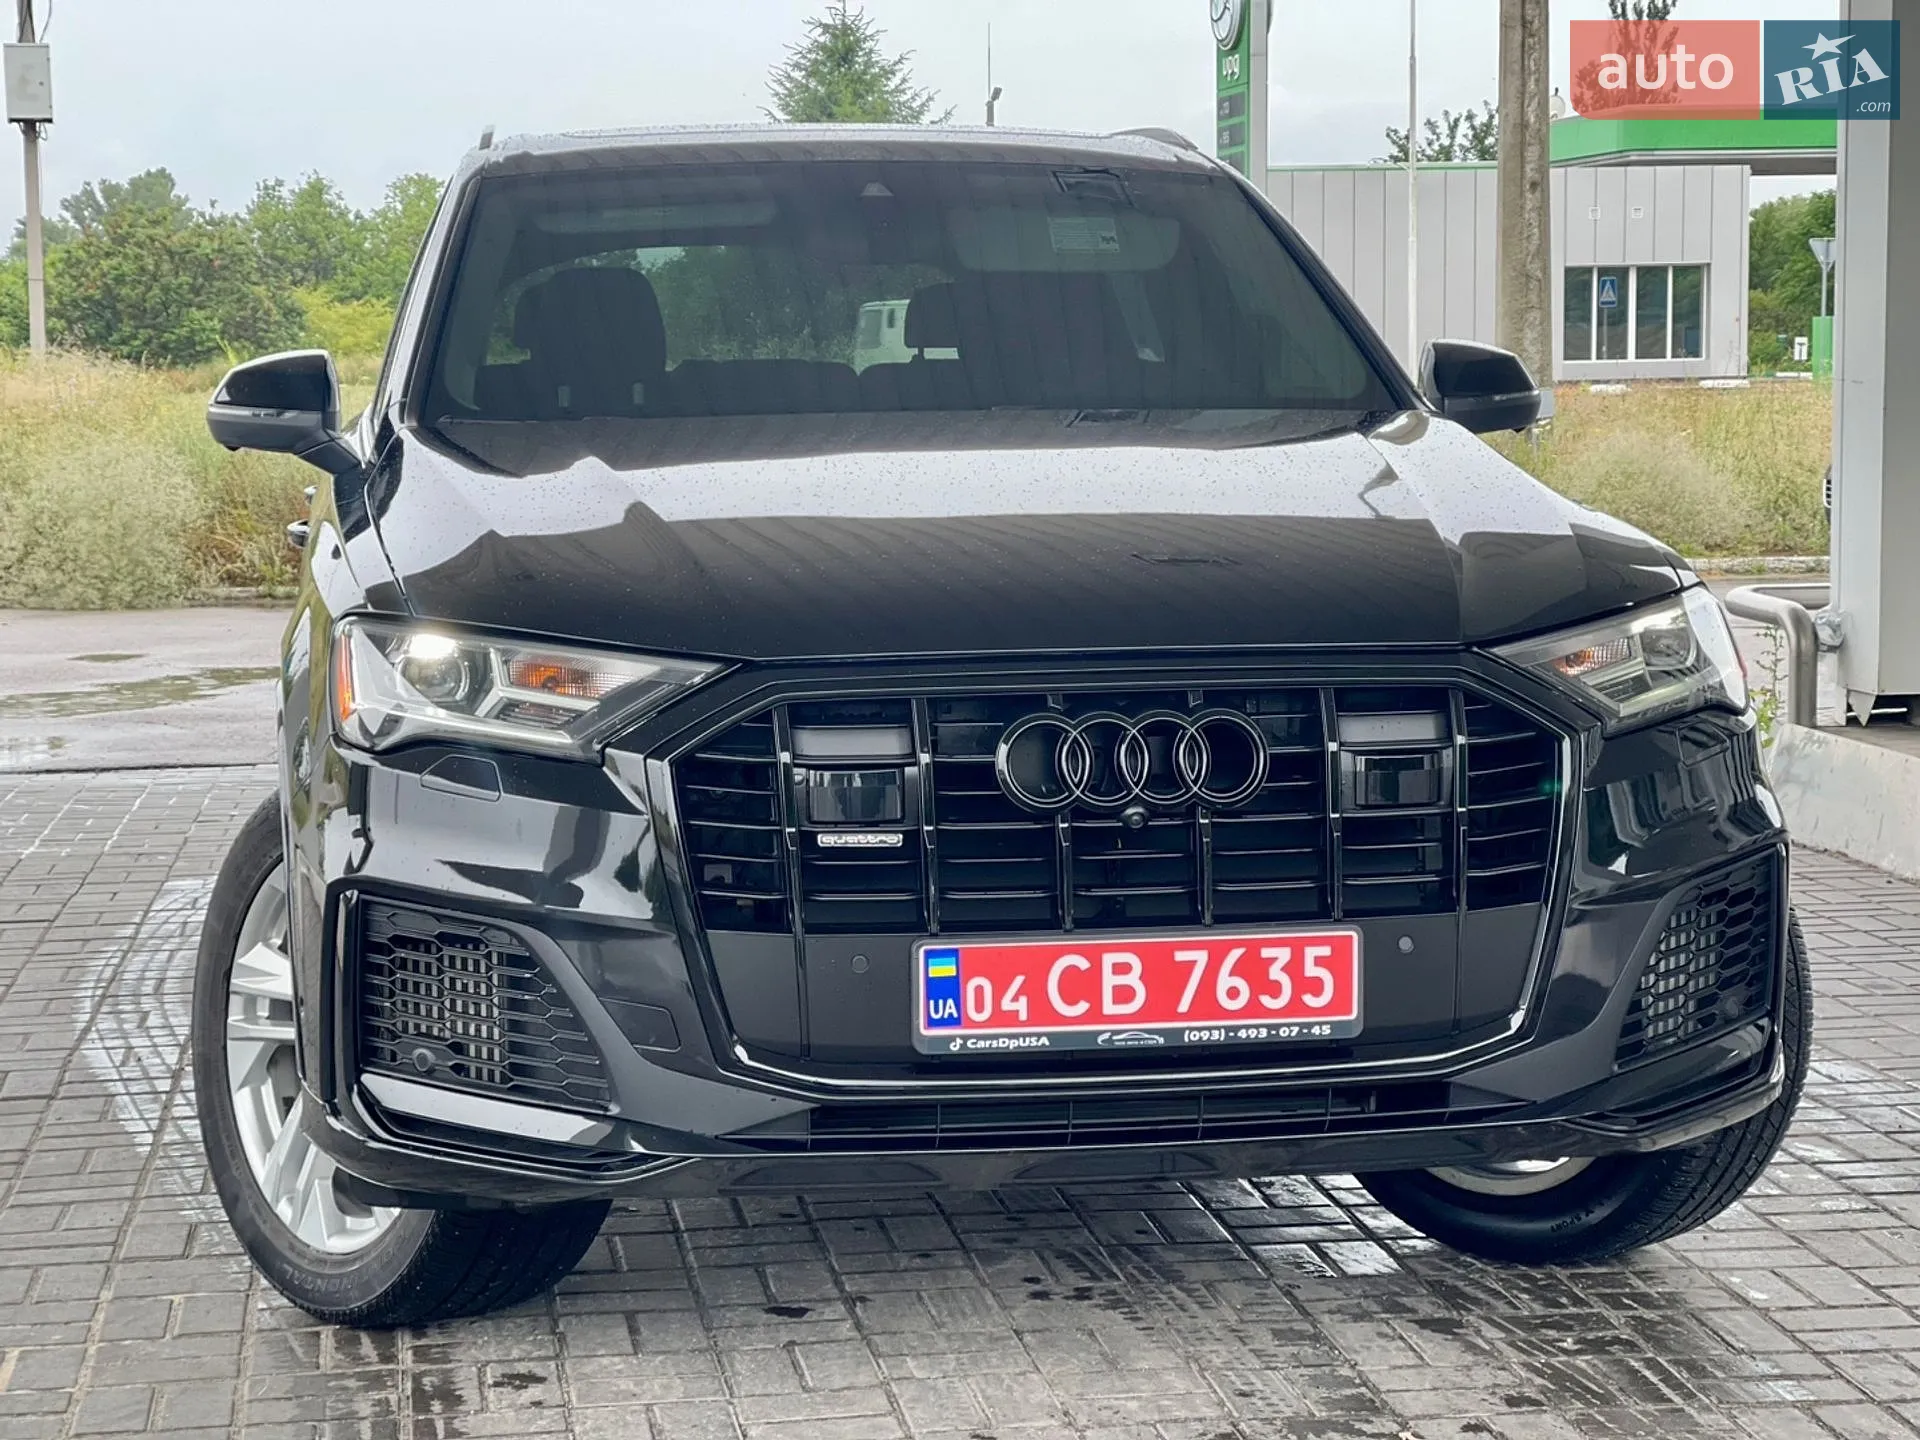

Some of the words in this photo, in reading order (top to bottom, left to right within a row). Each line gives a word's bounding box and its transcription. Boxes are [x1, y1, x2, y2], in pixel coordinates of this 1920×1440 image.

[821, 834, 899, 846] quattro
[966, 974, 1029, 1023] 04
[1047, 951, 1147, 1018] CB
[1173, 945, 1335, 1014] 7635
[929, 998, 958, 1020] UA
[966, 1036, 1050, 1050] CarsDpUSA
[1183, 1028, 1225, 1043] (093)
[1237, 1027, 1268, 1040] 493
[1279, 1026, 1300, 1038] 07
[1310, 1024, 1331, 1036] 45
